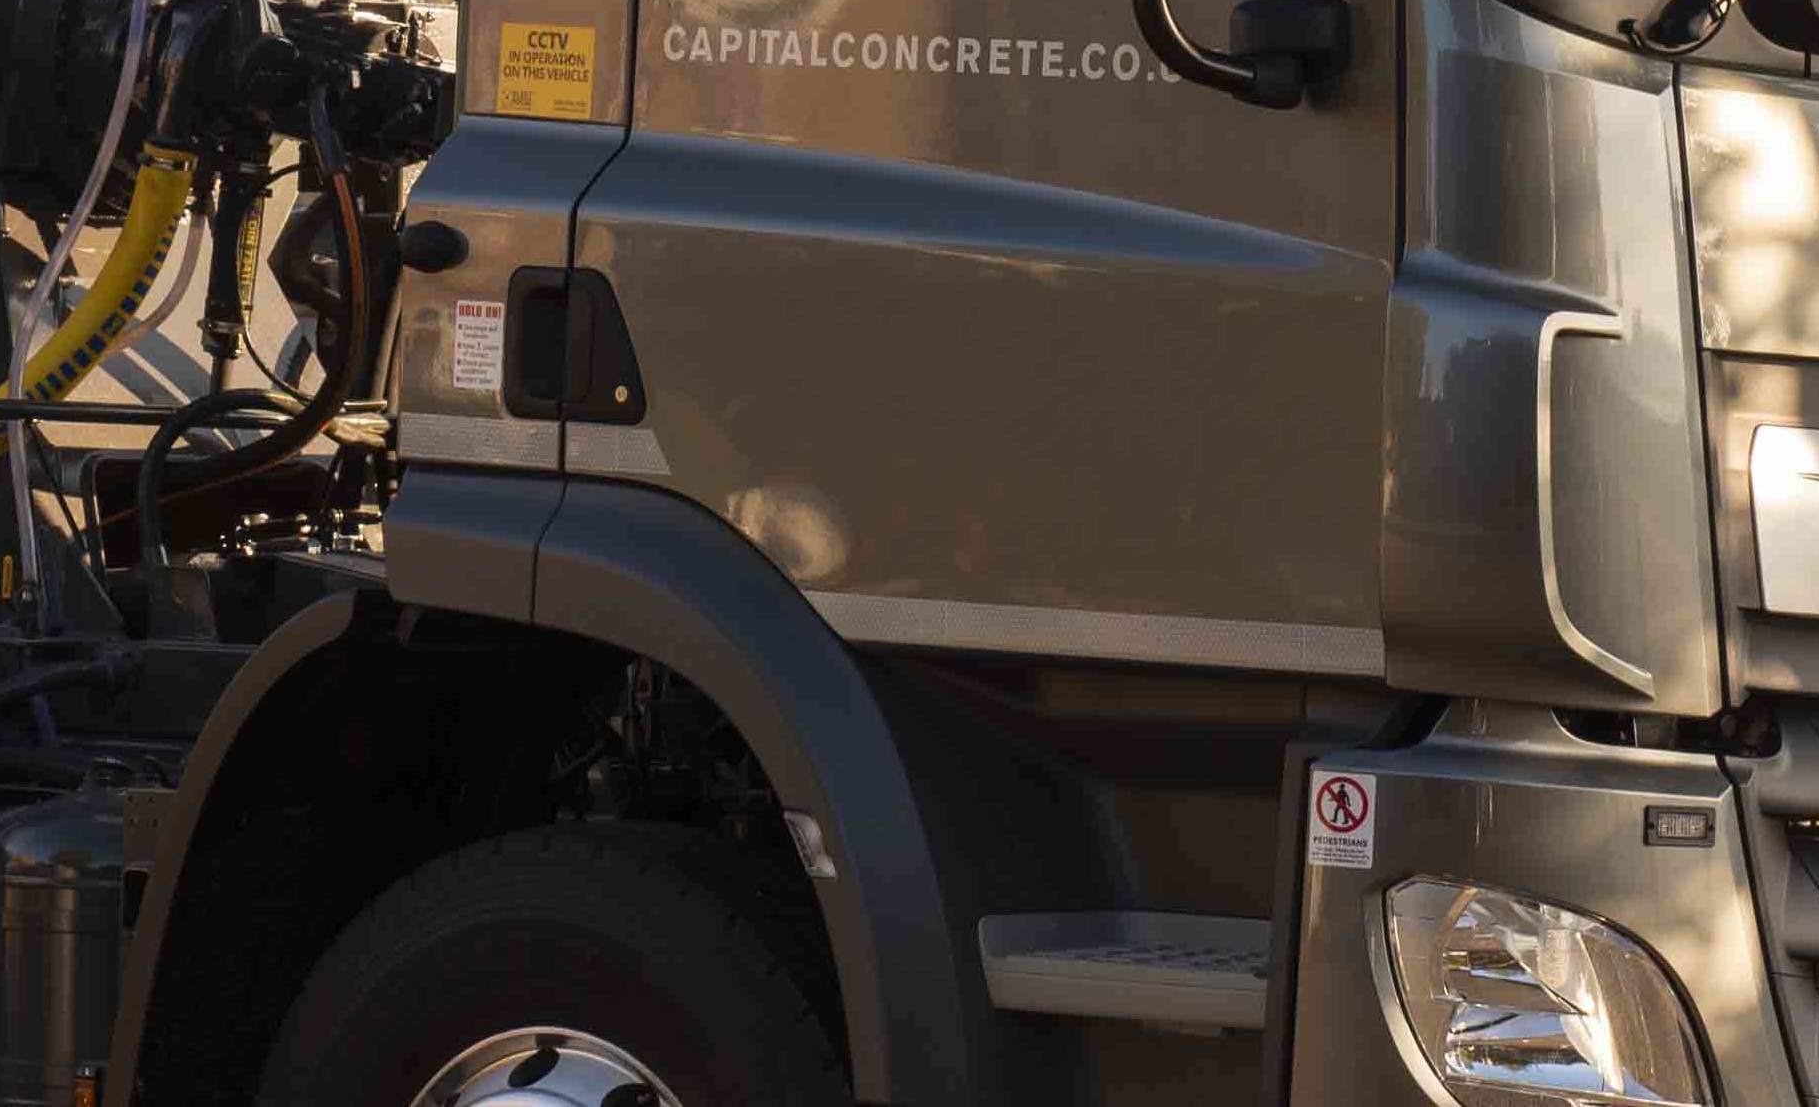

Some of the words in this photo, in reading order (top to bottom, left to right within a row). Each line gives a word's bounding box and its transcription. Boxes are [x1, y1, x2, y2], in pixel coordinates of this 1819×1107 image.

[528, 31, 569, 49] CCTV
[509, 51, 520, 62] IN
[523, 52, 586, 66] OPERATION
[503, 66, 520, 78] ON
[523, 67, 545, 80] THIS
[546, 69, 590, 83] VEHICLE
[1313, 835, 1368, 847] PEDESTRIANS
